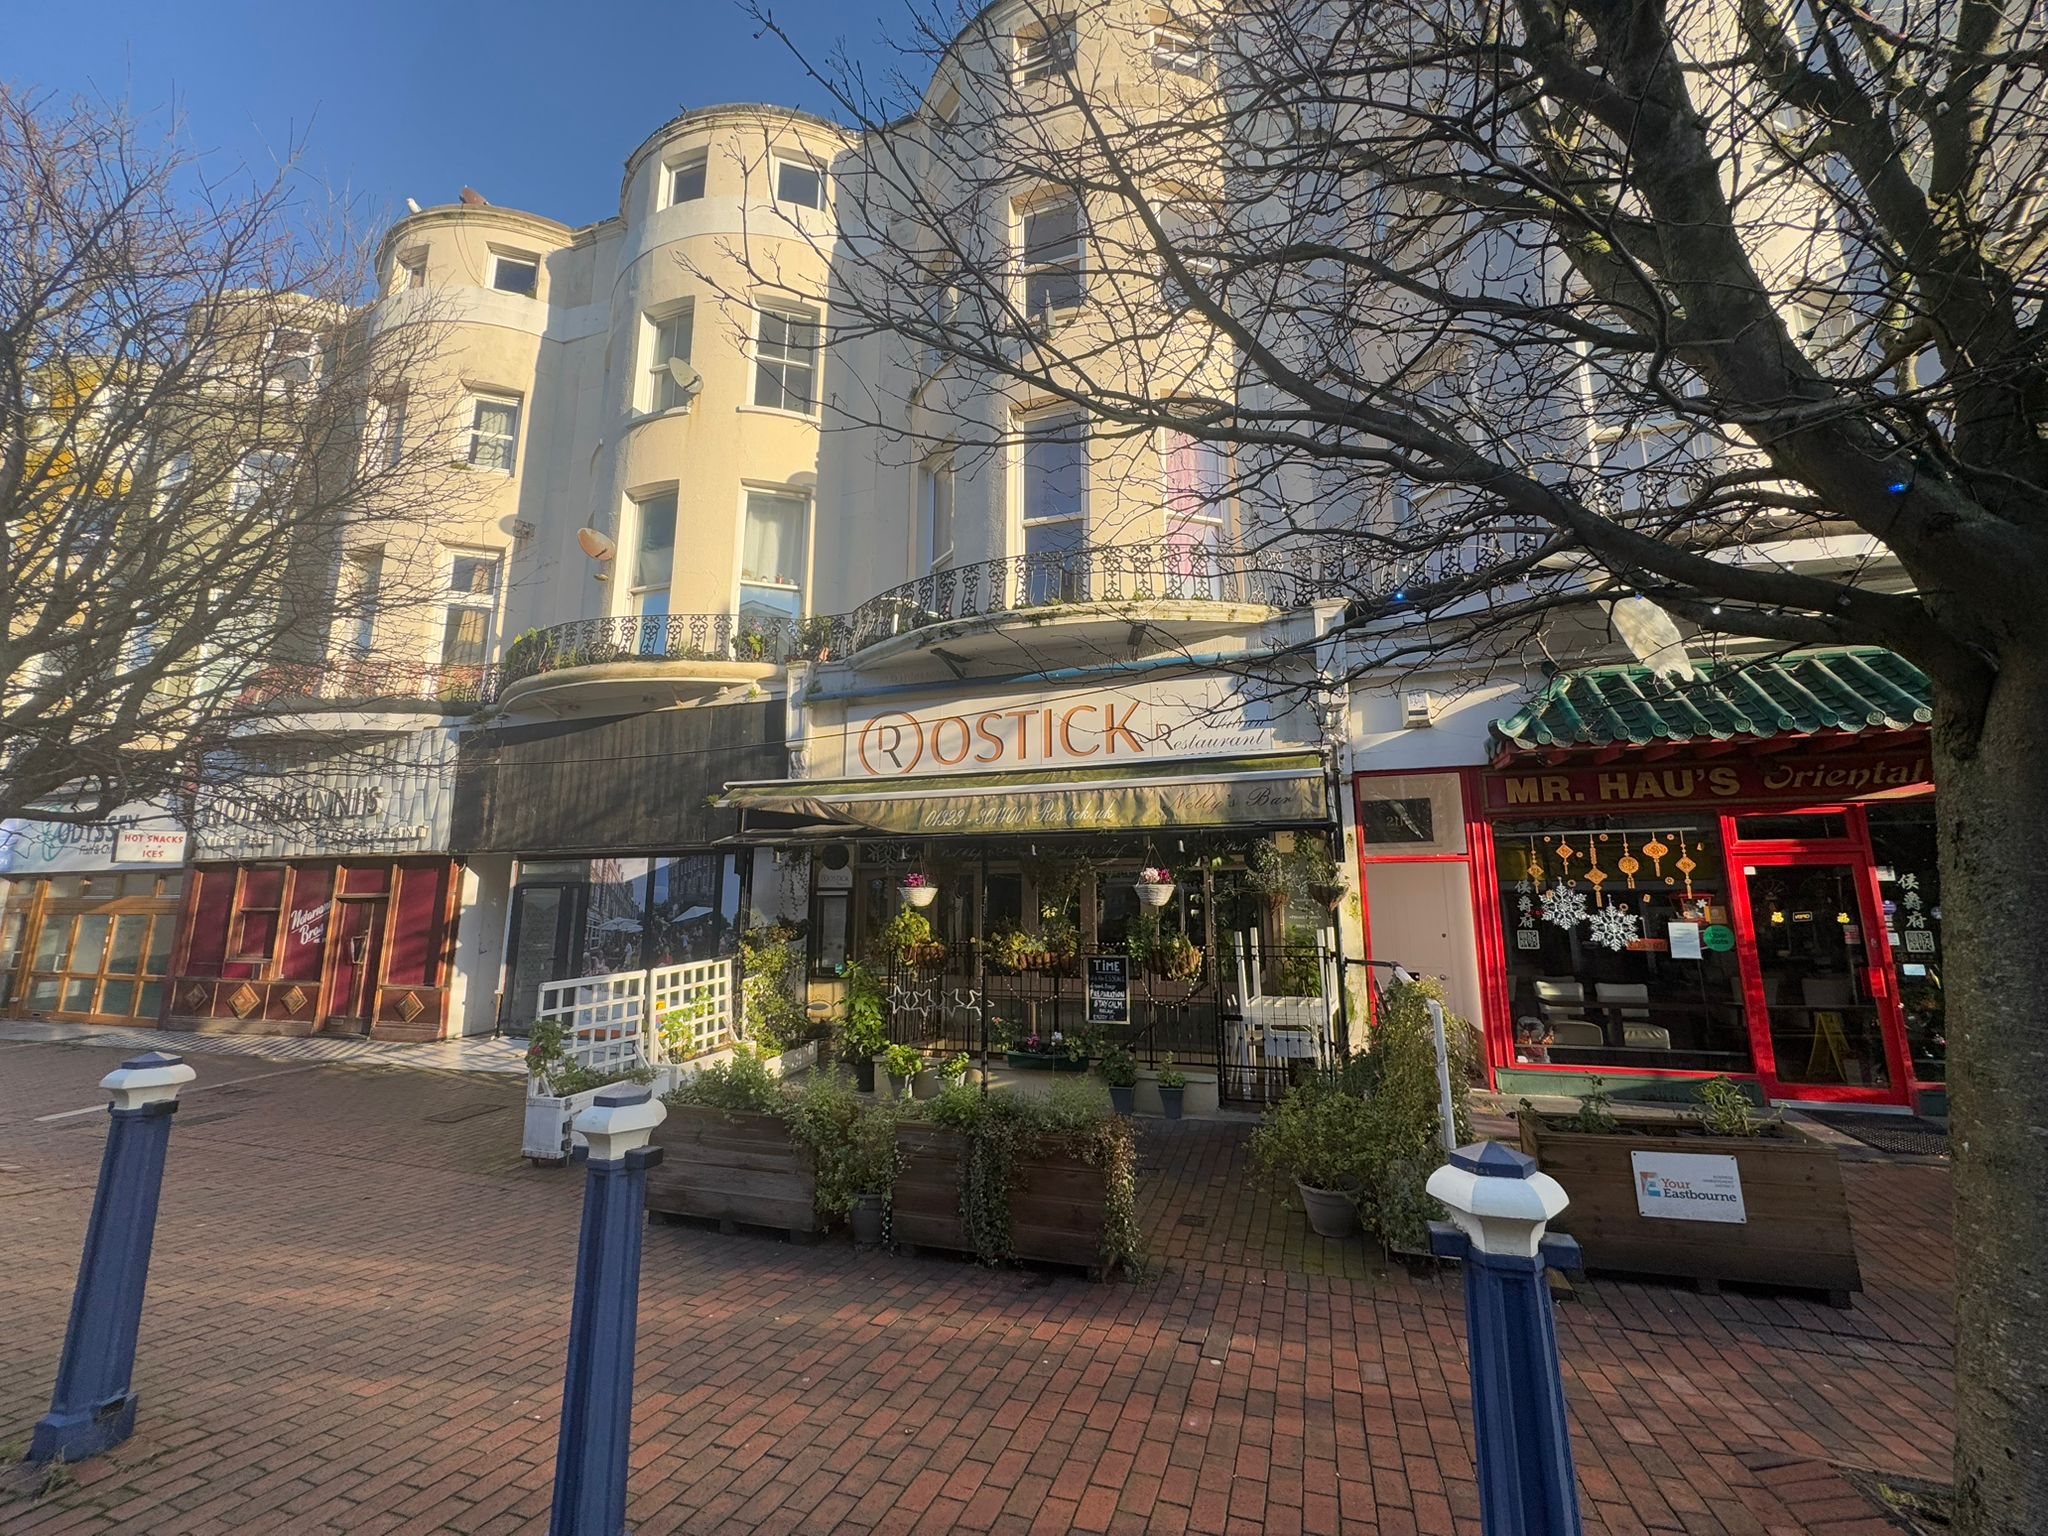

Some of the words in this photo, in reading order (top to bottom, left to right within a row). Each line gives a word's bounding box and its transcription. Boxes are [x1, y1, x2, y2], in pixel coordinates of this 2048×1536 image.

[859, 701, 1144, 775] ROSTICK
[1156, 722, 1265, 750] Restaurant
[1505, 775, 1585, 804] MR.
[1598, 767, 1741, 799] HAU'S
[1764, 758, 1925, 789] Oriental
[1247, 786, 1293, 806] Bar
[925, 810, 966, 827] 01323
[124, 835, 143, 843] HOT
[147, 834, 184, 844] SNACKS
[142, 850, 164, 858] ICES
[1093, 959, 1120, 972] TIME
[1661, 1178, 1691, 1190] Your
[1663, 1188, 1737, 1203] Eastbourne
